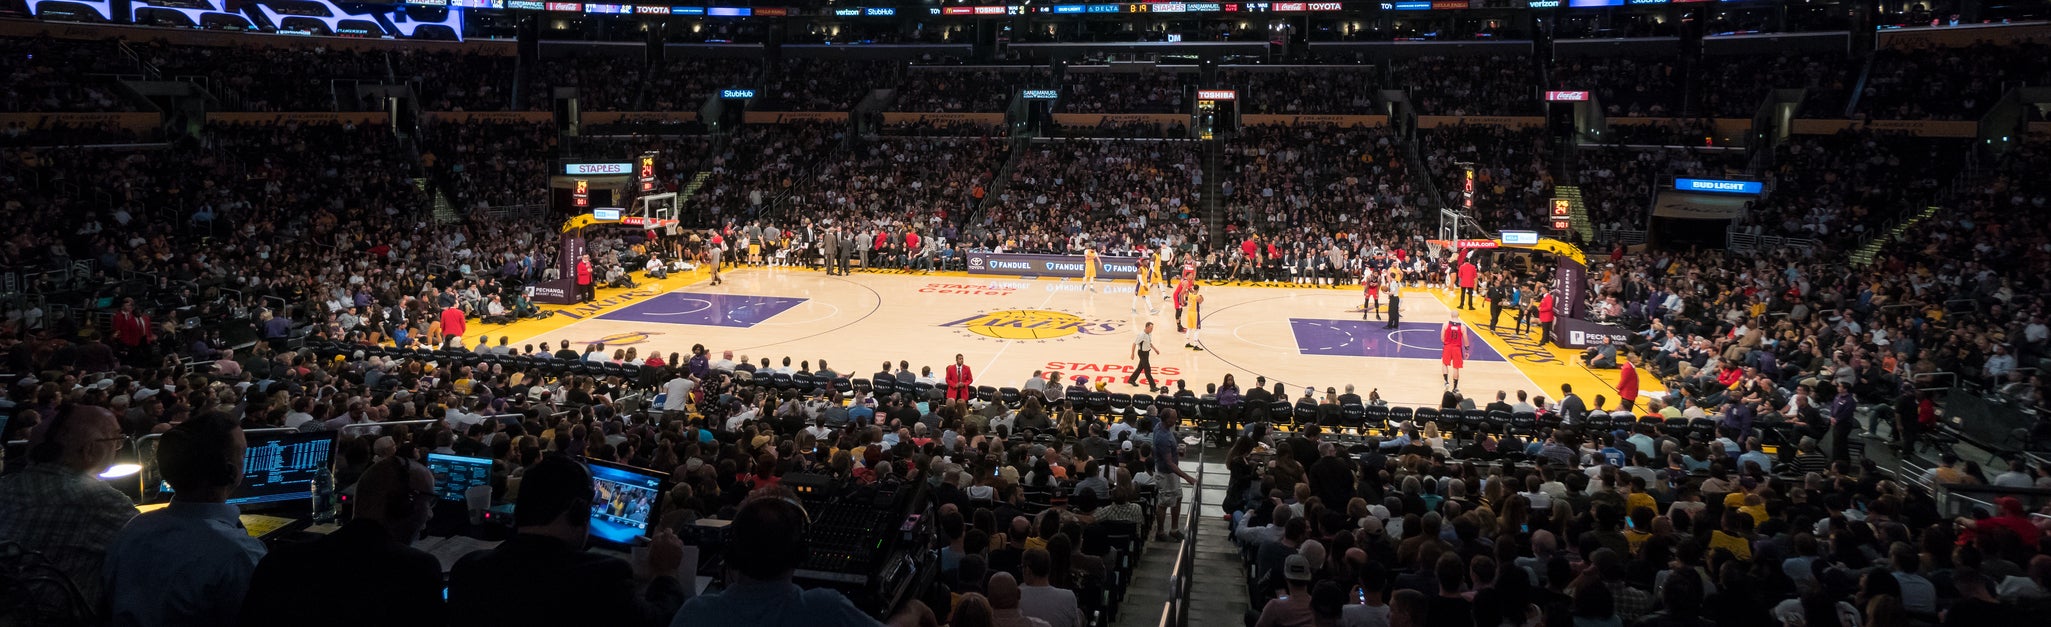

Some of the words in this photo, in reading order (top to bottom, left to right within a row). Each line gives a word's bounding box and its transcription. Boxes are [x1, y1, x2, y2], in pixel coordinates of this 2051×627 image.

[1557, 92, 1583, 100] Coca-Cola
[999, 261, 1031, 269] FANDUEL
[1056, 263, 1085, 271] FANDUE
[1113, 265, 1137, 273] FANDU
[918, 288, 1013, 296] Center
[938, 314, 1118, 336] LAKERS
[1586, 333, 1627, 341] PECHNGA
